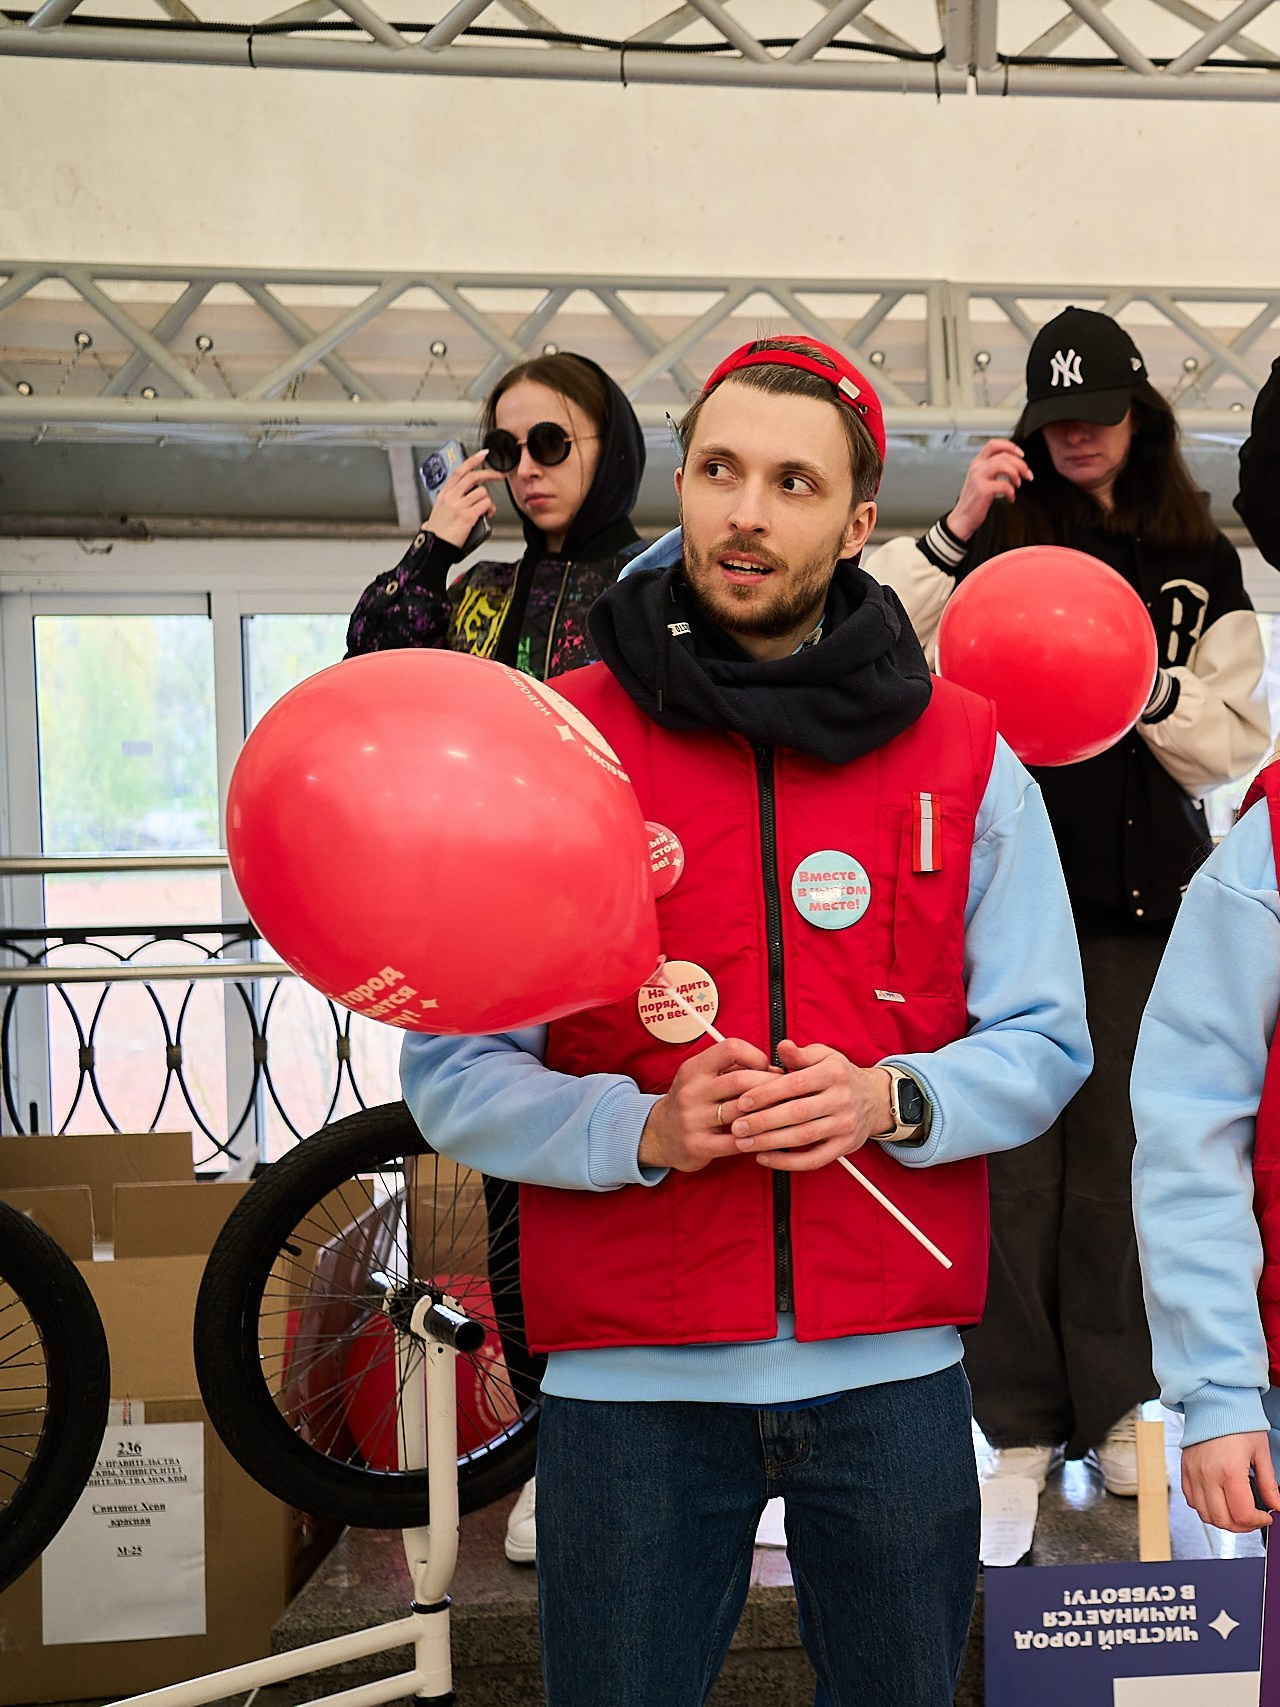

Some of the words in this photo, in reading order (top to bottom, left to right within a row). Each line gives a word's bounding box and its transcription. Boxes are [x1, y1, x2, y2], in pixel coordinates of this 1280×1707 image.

[1050, 349, 1083, 387] NY
[649, 832, 669, 849] ый
[650, 839, 679, 861] стой
[651, 856, 670, 872] ве!
[798, 871, 856, 882] Вместе
[797, 888, 807, 897] в
[809, 899, 860, 912] месте!
[340, 966, 406, 1004] город
[648, 981, 710, 999] Надить
[362, 985, 418, 1017] ается
[640, 995, 694, 1013] порядк
[644, 1013, 665, 1024] это
[667, 1001, 715, 1019] весло!
[117, 1441, 142, 1456] 236
[87, 1477, 146, 1487] ВИТЕЛЬСТВА
[1063, 1585, 1177, 1606] СУББОТУ!
[1180, 1585, 1196, 1600] В
[1043, 1605, 1197, 1628] НАЧИНАЕТСЯ
[1013, 1630, 1093, 1650] ГОРОД
[1098, 1626, 1199, 1651] ЧИСТЫЙ
